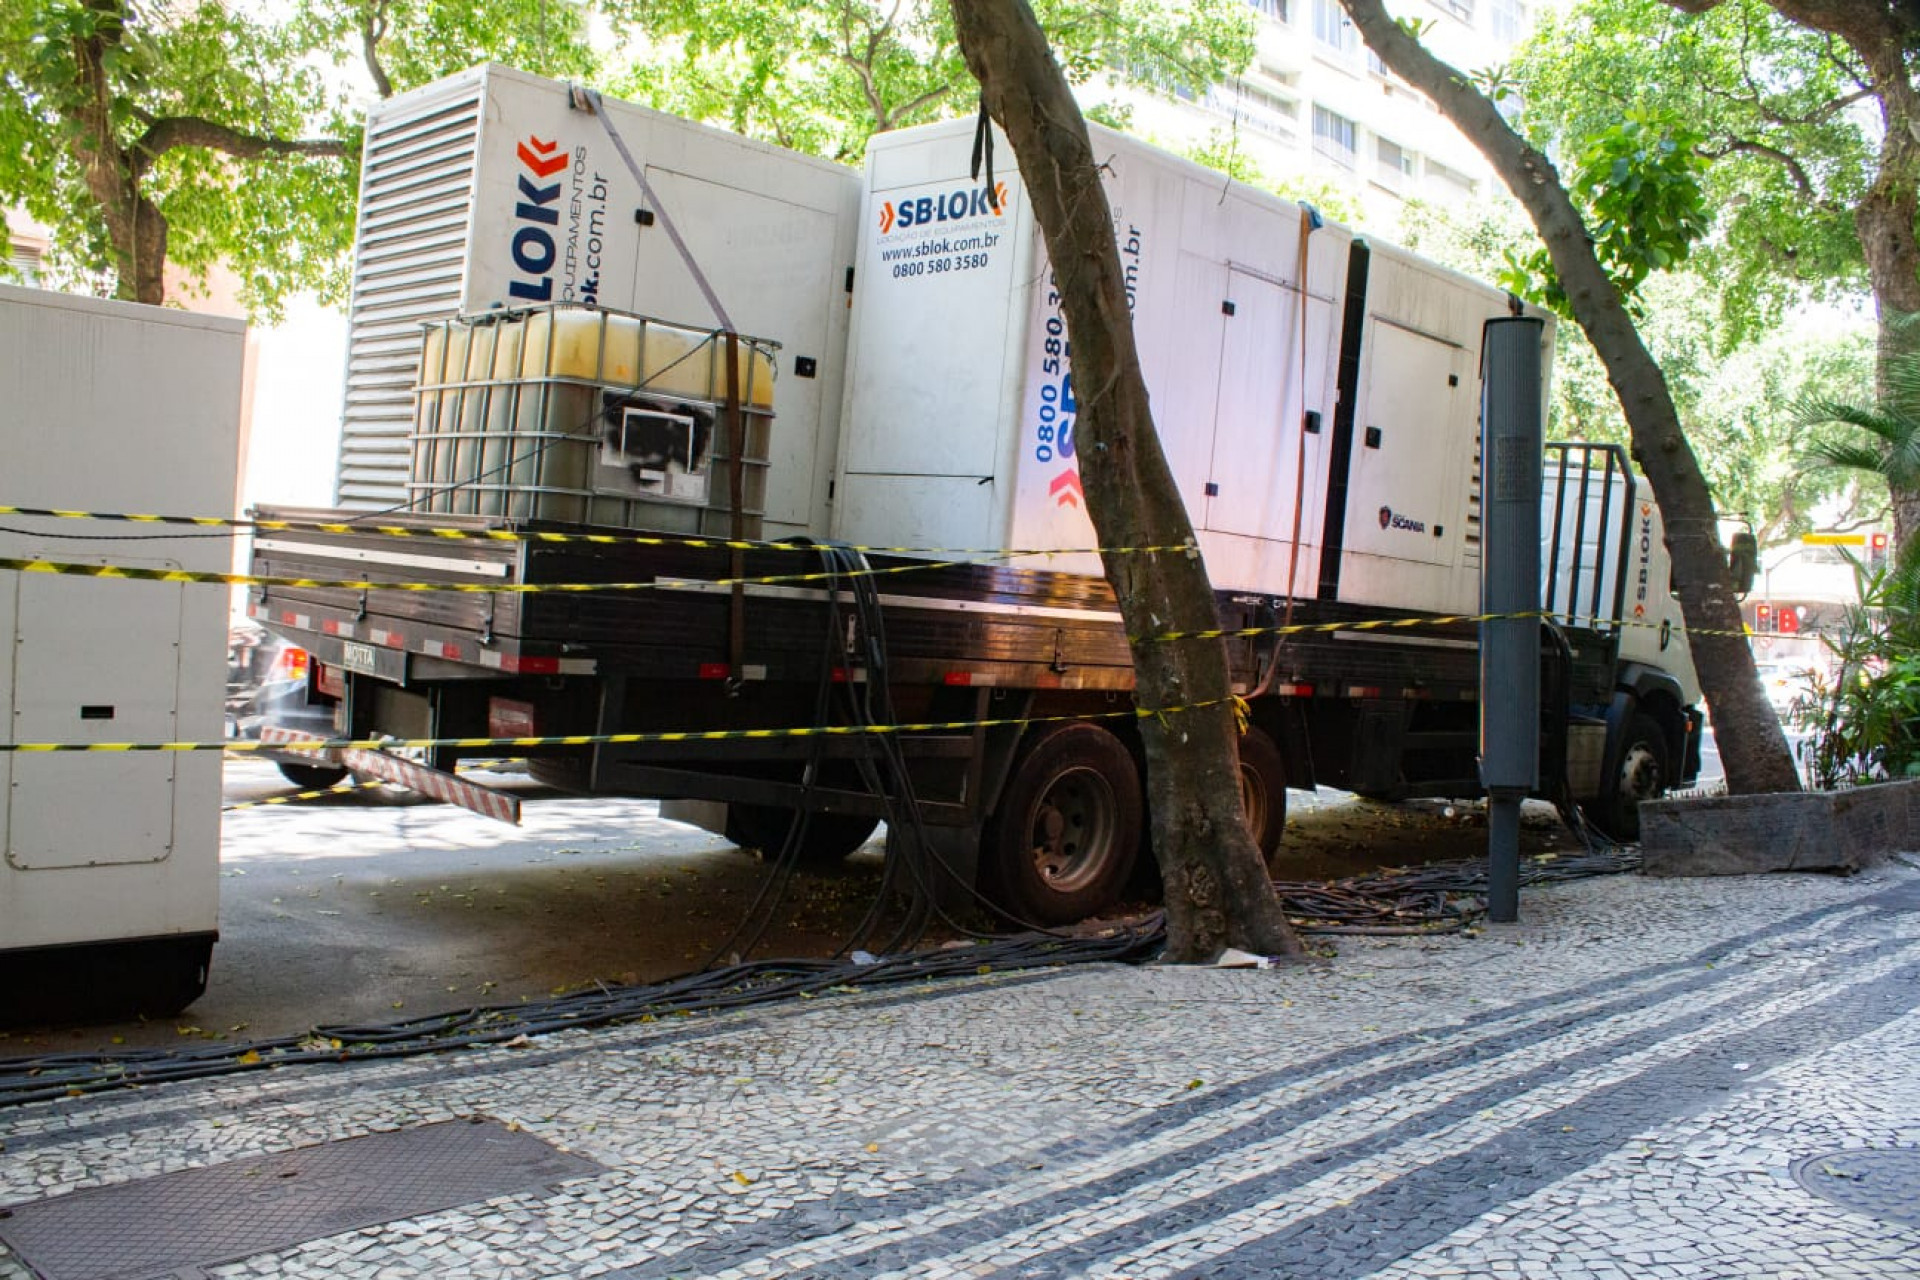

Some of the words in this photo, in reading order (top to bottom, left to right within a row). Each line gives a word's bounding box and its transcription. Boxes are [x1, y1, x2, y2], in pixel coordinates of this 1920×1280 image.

[882, 230, 1000, 262] www.sblok.com.br
[892, 261, 924, 279] 0800
[926, 257, 952, 275] 580
[954, 252, 989, 271] 3580
[1043, 317, 1063, 376] 580
[1036, 384, 1058, 463] 0800
[1391, 515, 1425, 533] SCANIA
